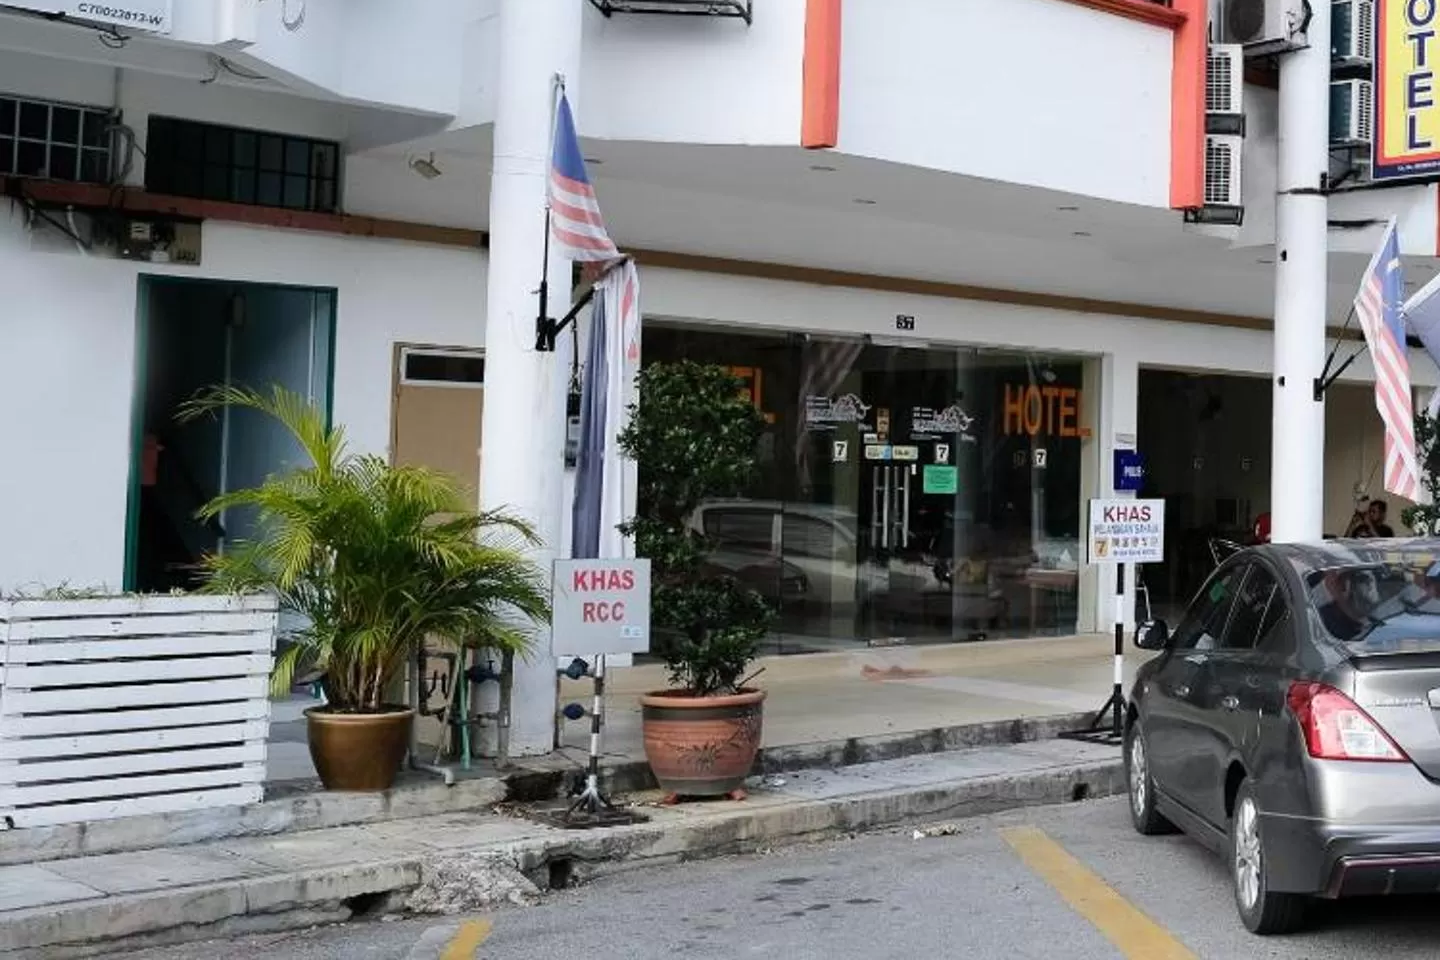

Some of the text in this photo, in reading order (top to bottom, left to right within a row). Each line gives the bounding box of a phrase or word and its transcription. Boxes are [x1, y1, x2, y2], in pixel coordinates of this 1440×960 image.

[1003, 383, 1092, 437] HOTEL
[1103, 505, 1152, 523] KHAS
[573, 569, 635, 592] KHAS
[583, 602, 625, 622] RCC
